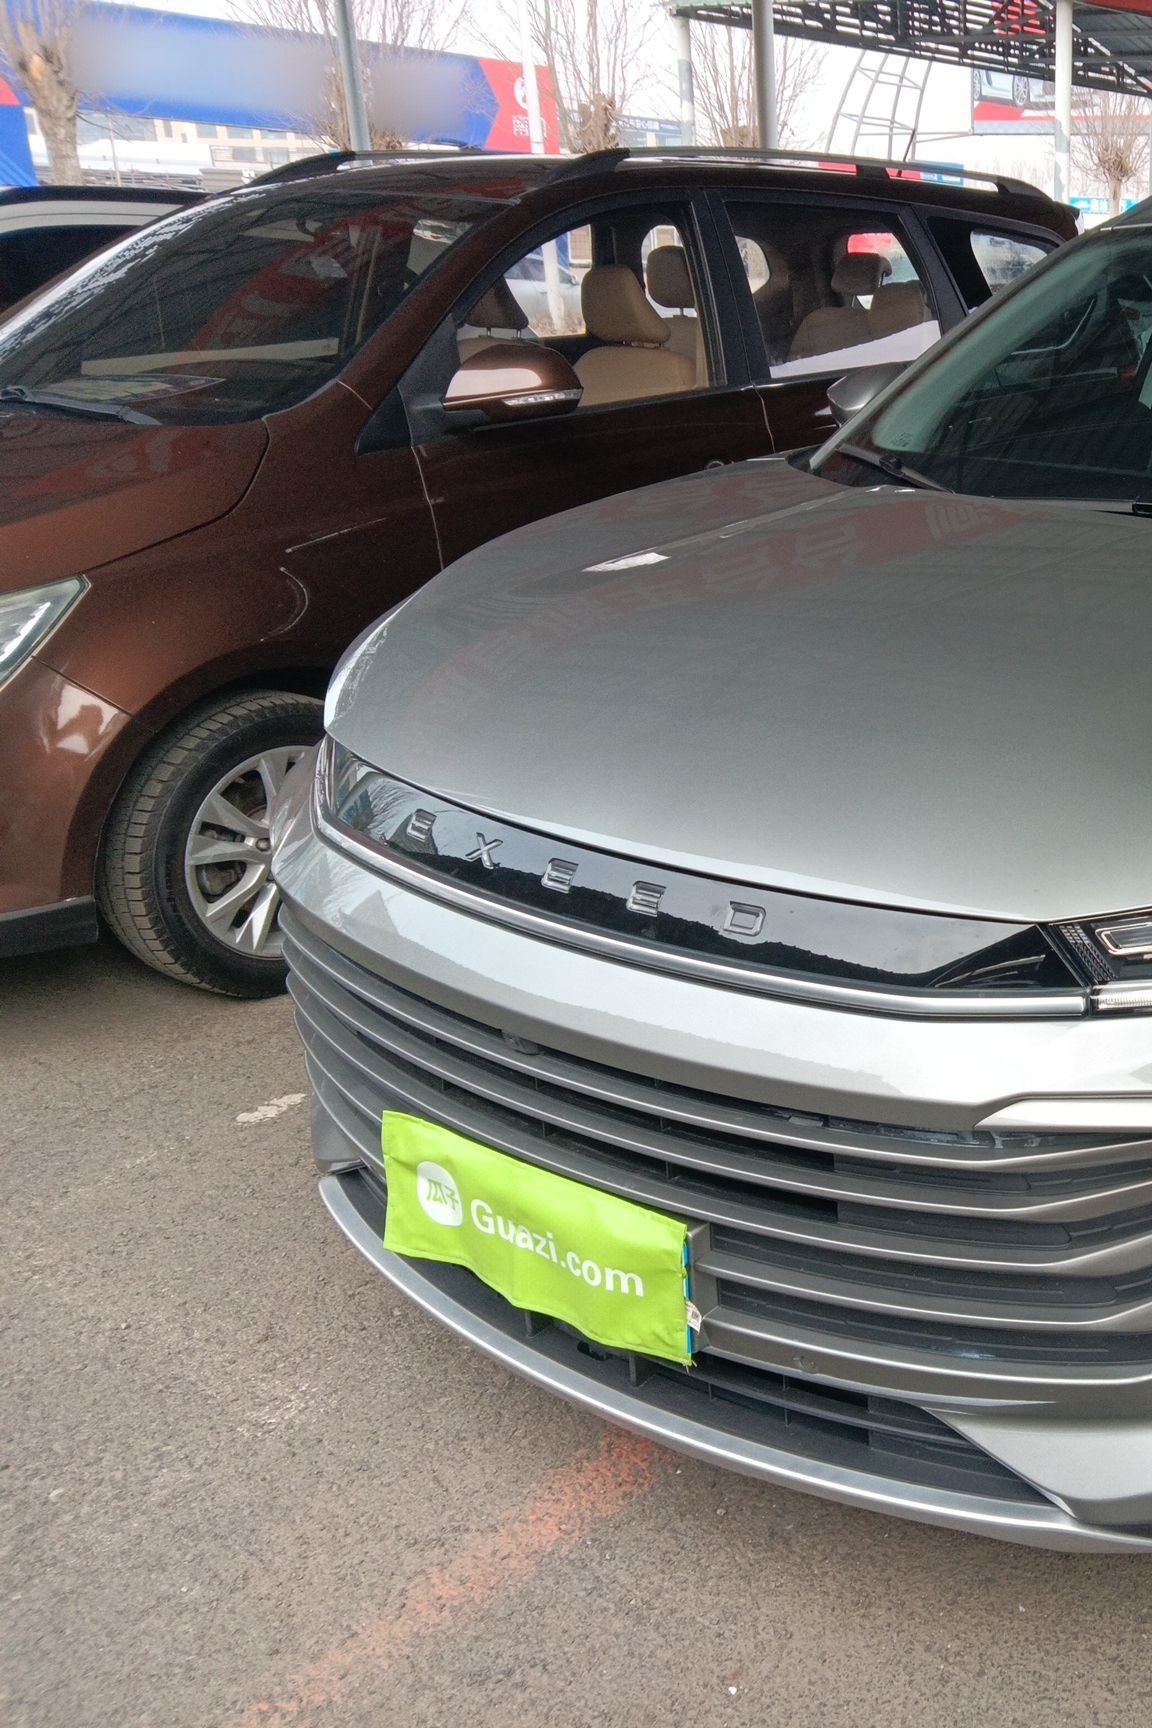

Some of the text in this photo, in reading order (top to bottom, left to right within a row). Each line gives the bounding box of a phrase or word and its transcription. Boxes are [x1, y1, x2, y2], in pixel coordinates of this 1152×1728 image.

[406, 808, 767, 938] EXEED
[426, 1177, 459, 1211] 瓜子
[470, 1198, 645, 1298] Guazi.com
